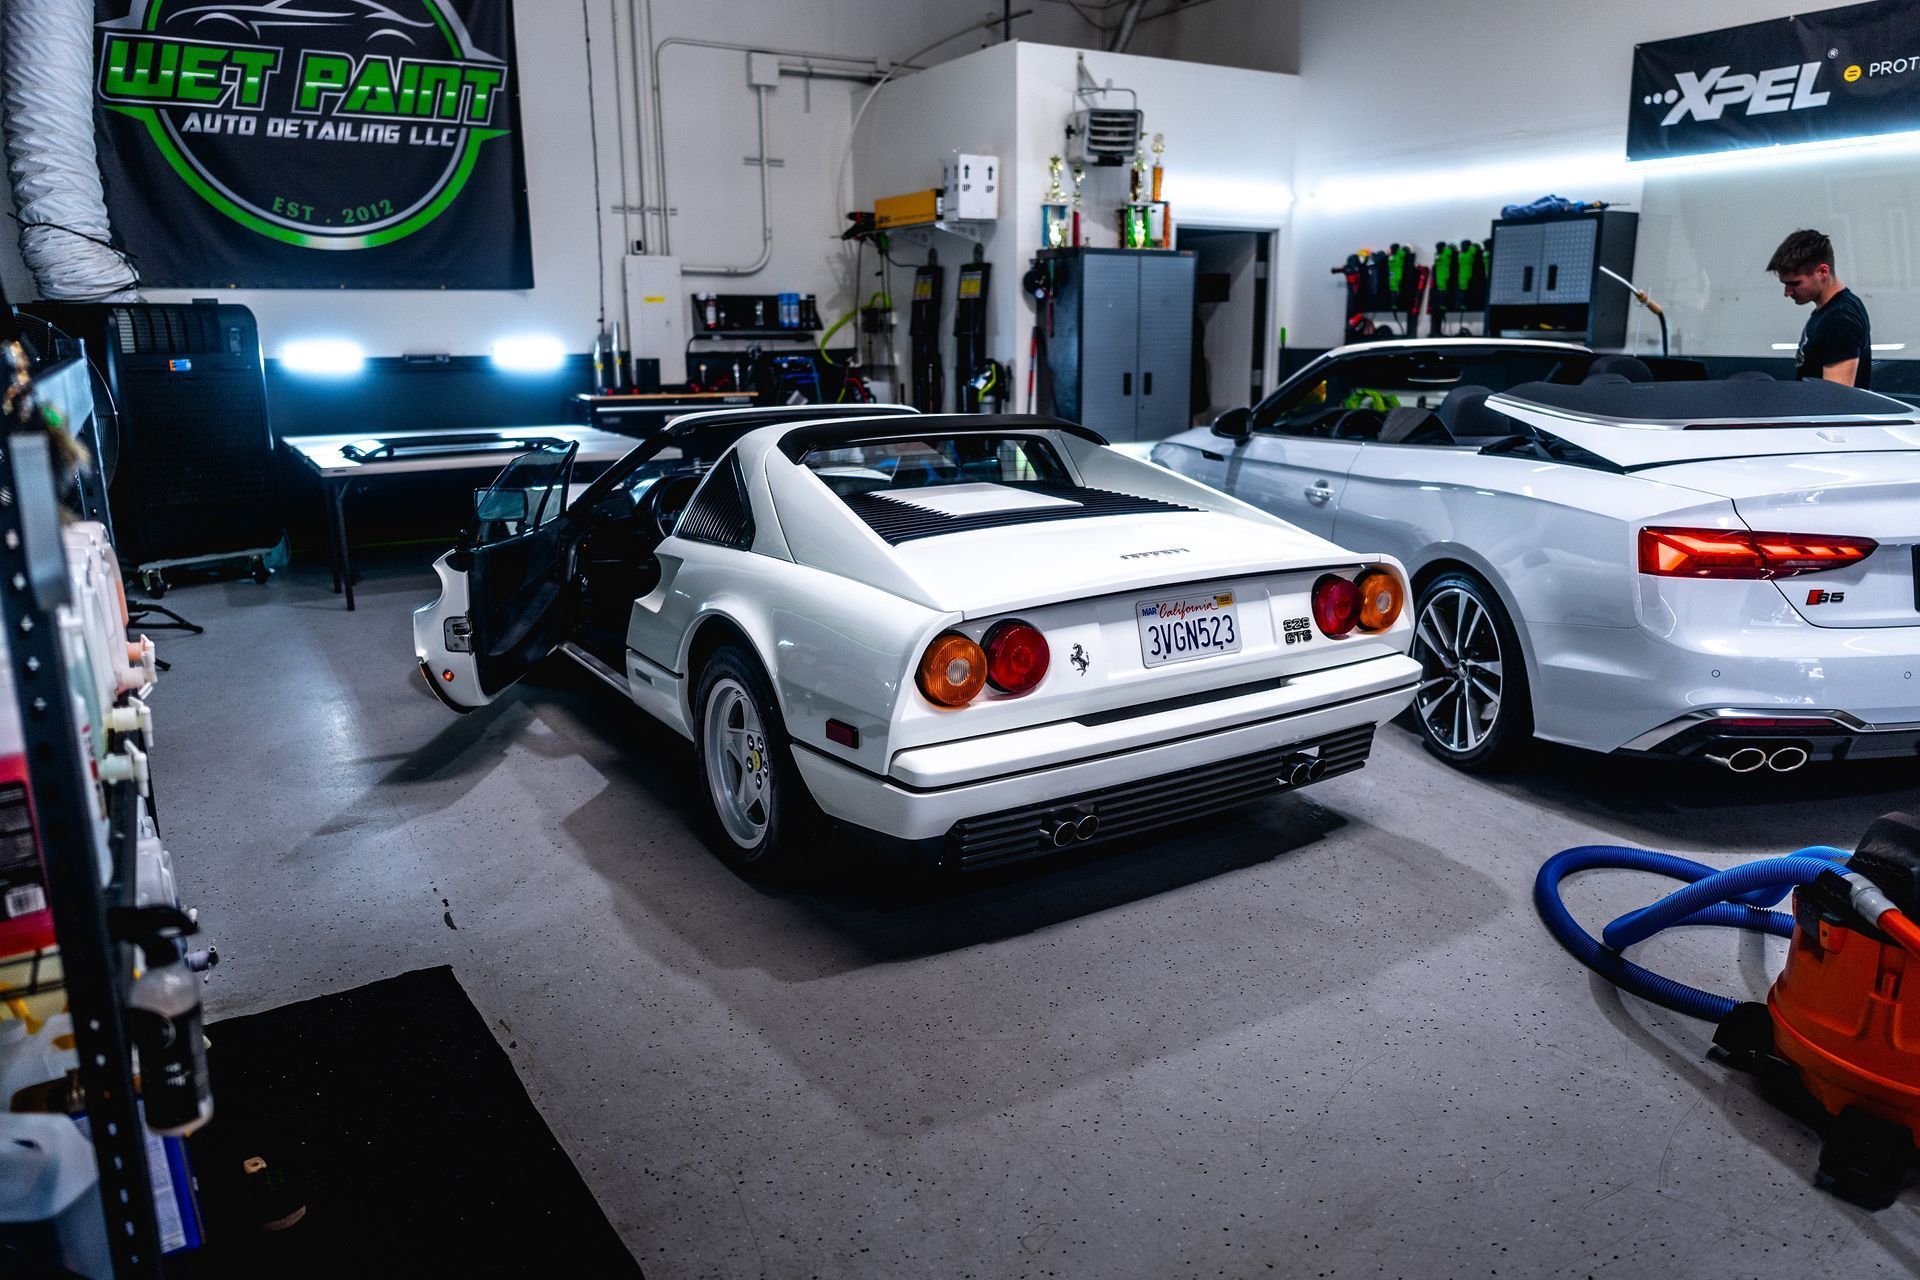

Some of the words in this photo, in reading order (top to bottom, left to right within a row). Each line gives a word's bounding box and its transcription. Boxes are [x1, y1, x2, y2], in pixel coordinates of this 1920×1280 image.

[1869, 56, 1920, 77] PROT
[103, 38, 278, 106] WET
[297, 54, 503, 121] PAINT
[1660, 61, 1831, 127] XPEL
[181, 111, 258, 136] AUTO
[266, 117, 401, 144] DETAILING
[409, 126, 457, 147] LLC
[272, 196, 315, 221] EST
[342, 199, 394, 224] 2012
[1159, 600, 1218, 619] California
[1816, 592, 1845, 604] S5
[1142, 606, 1157, 617] MAR
[1147, 614, 1235, 656] 3VGN523
[1285, 629, 1312, 645] GTS
